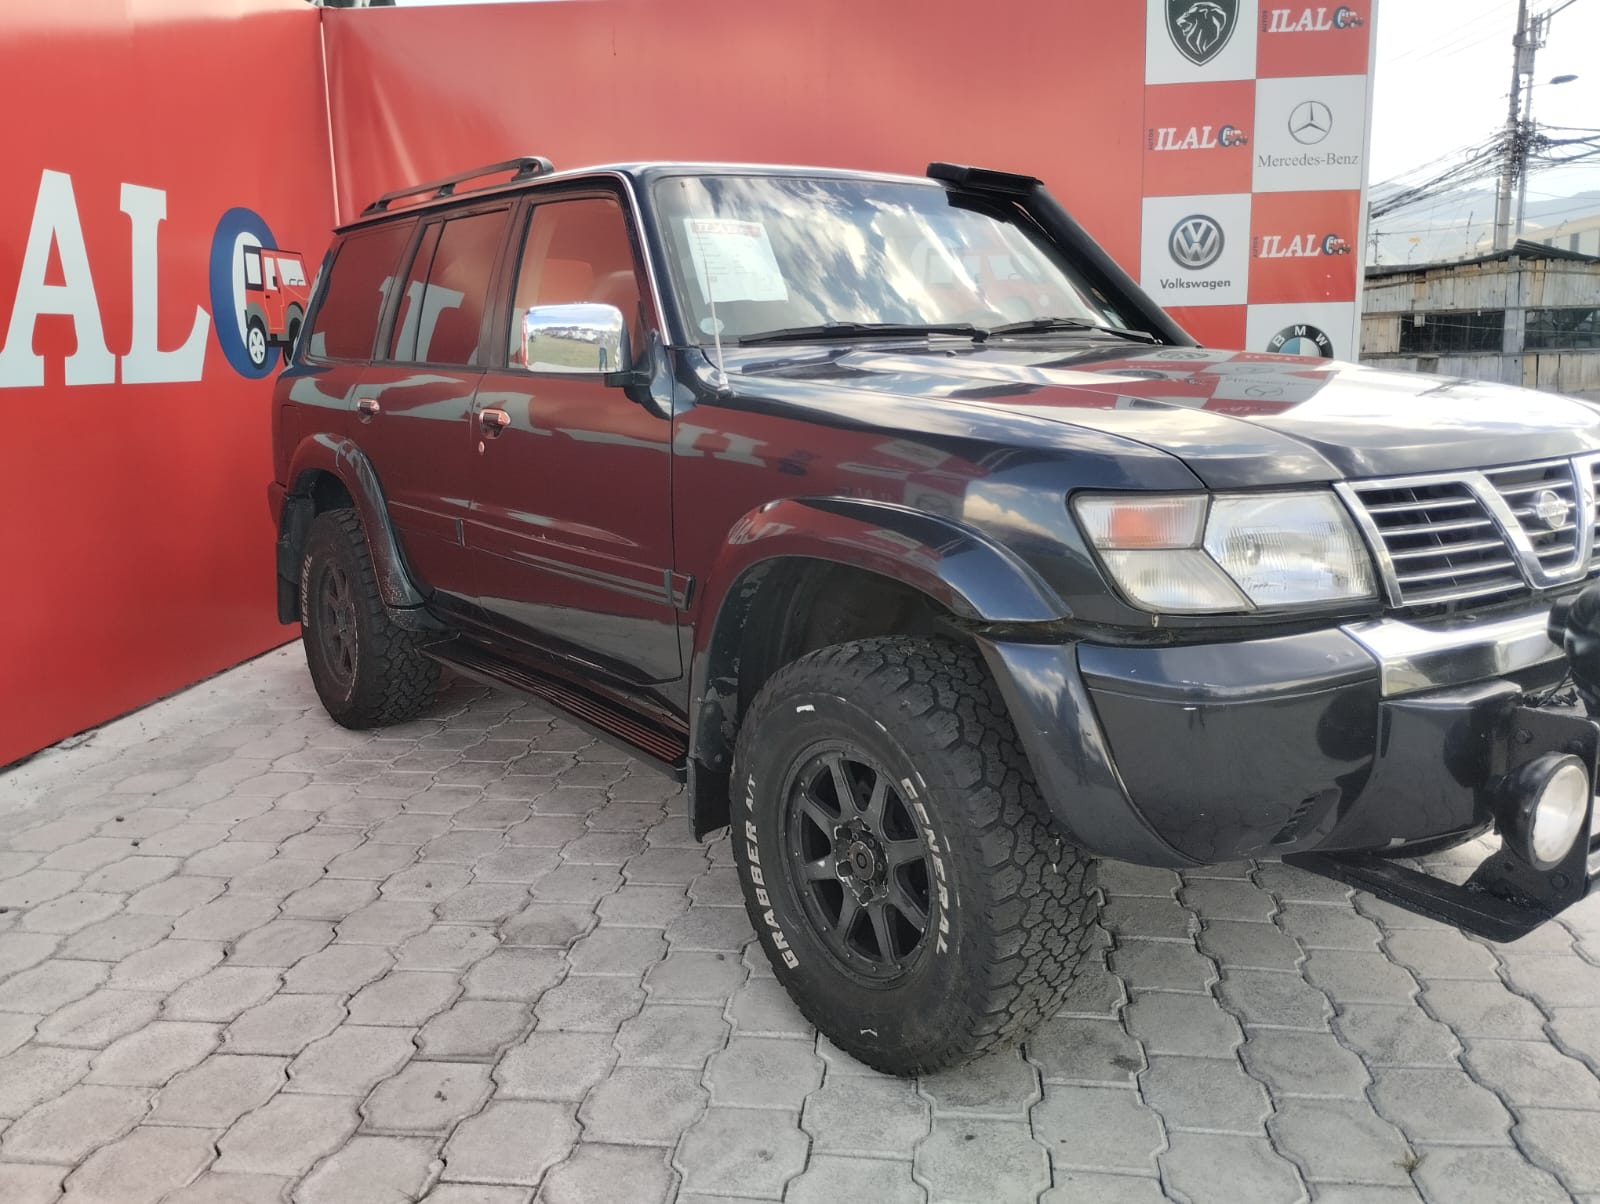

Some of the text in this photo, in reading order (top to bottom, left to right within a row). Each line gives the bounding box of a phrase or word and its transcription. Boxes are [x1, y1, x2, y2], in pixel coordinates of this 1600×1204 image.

[1258, 152, 1359, 168] Mercedes-Benz
[1160, 278, 1231, 290] Volkswagen
[1273, 325, 1328, 347] BMW
[901, 777, 949, 955] GENERAL
[745, 820, 799, 969] GRABBER
